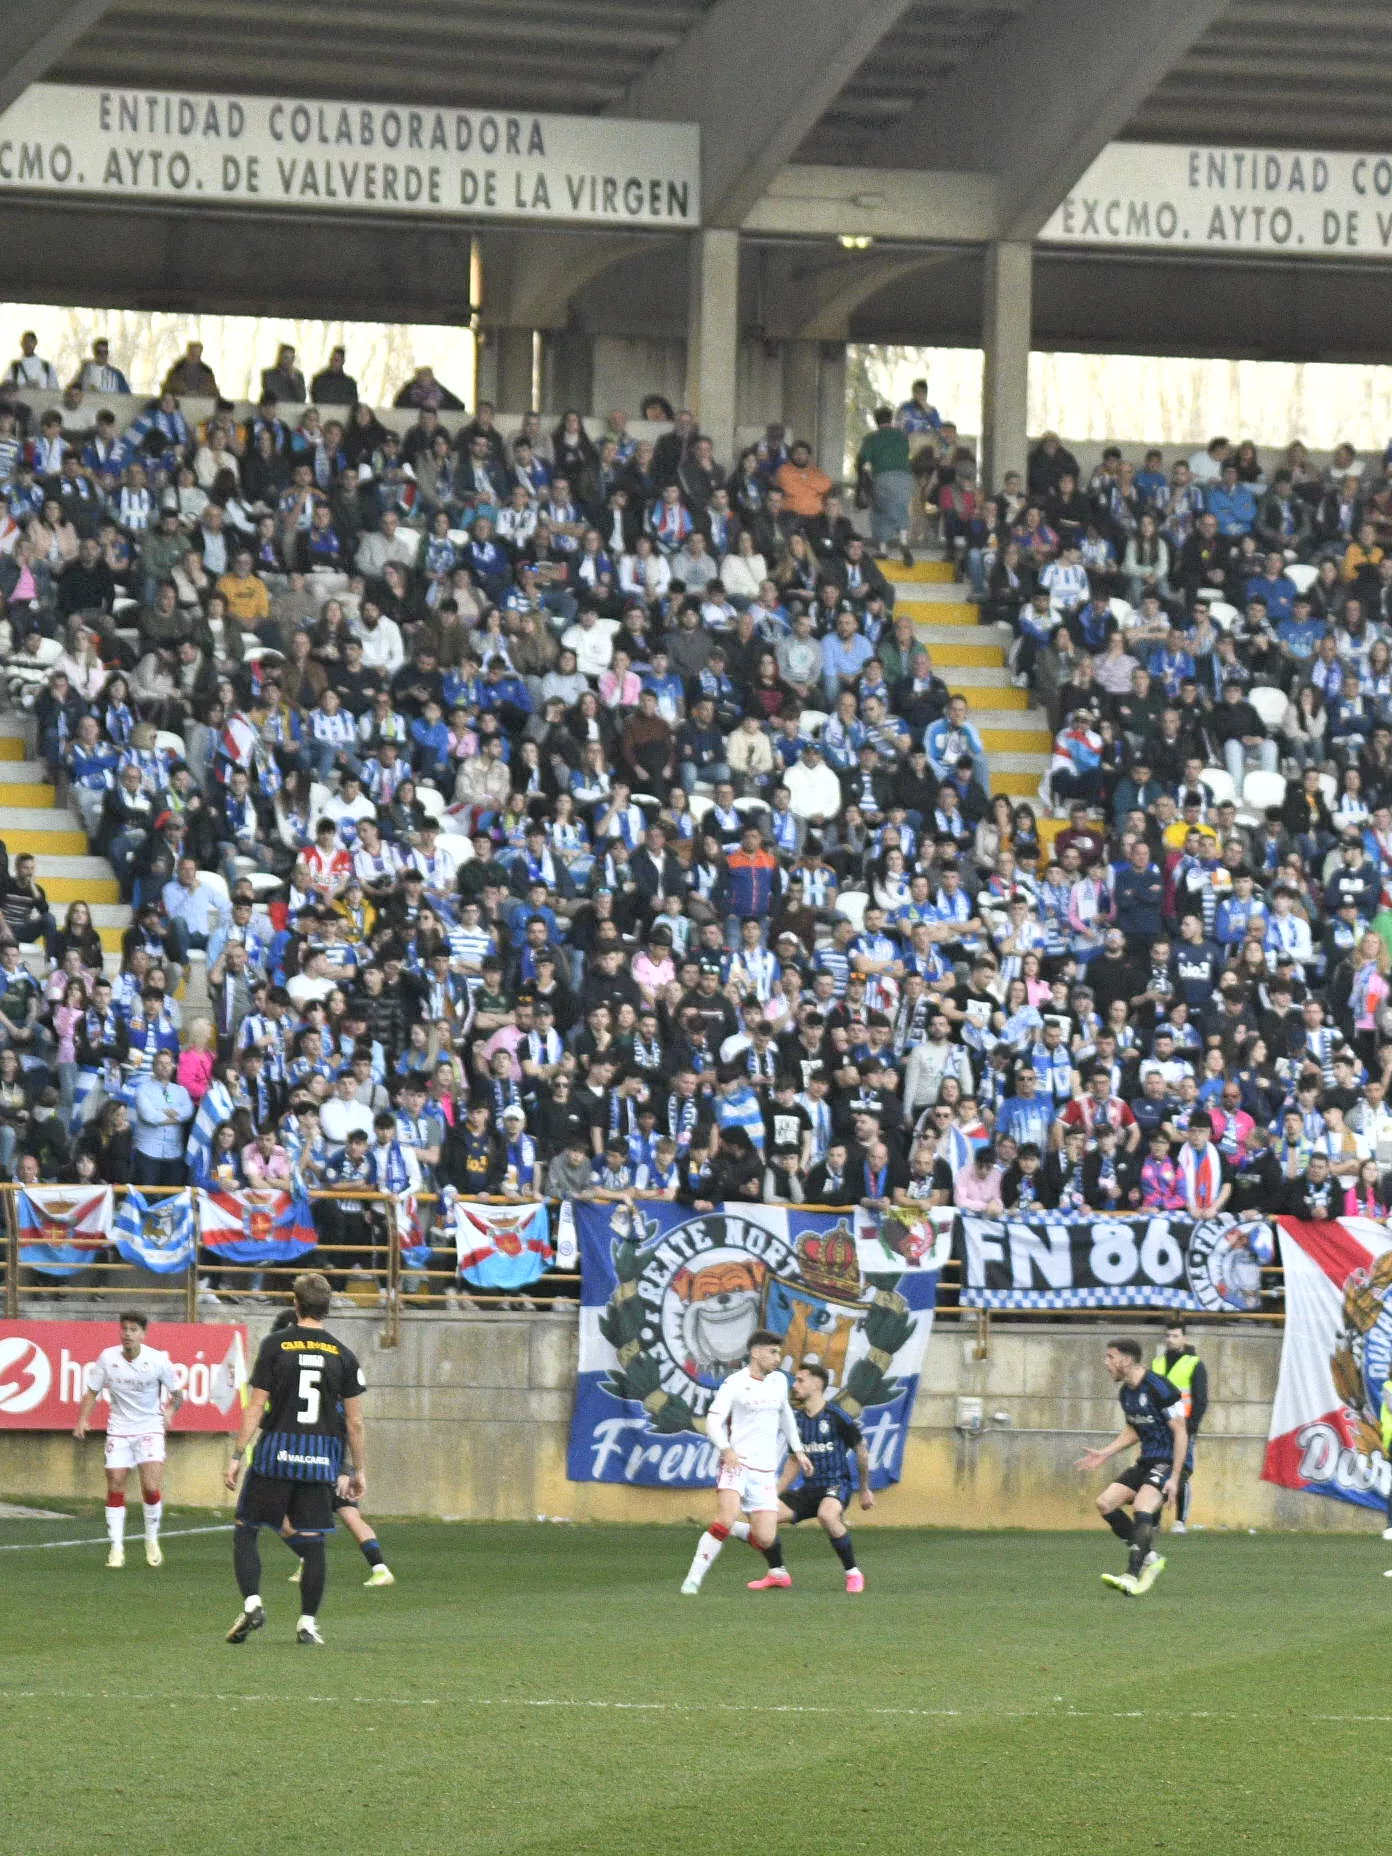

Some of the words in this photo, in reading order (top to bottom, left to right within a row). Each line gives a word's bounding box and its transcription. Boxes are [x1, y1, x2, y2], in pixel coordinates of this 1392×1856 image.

[99, 93, 244, 139] ENTIDAD
[269, 103, 546, 156] COLABORADORA
[103, 147, 203, 192] AYTO.
[222, 154, 259, 194] DE
[276, 157, 441, 205] VALVERDE
[461, 168, 497, 209] DE
[514, 172, 551, 211] LA
[565, 174, 690, 218] VIRGEN
[1187, 150, 1329, 193] ENTIDAD
[1062, 198, 1190, 239] EXCMO.
[1206, 204, 1305, 246] AYTO.
[1323, 209, 1358, 247] DE
[962, 1216, 1073, 1288] FN
[1089, 1217, 1183, 1286] 86
[297, 1369, 321, 1424] 5
